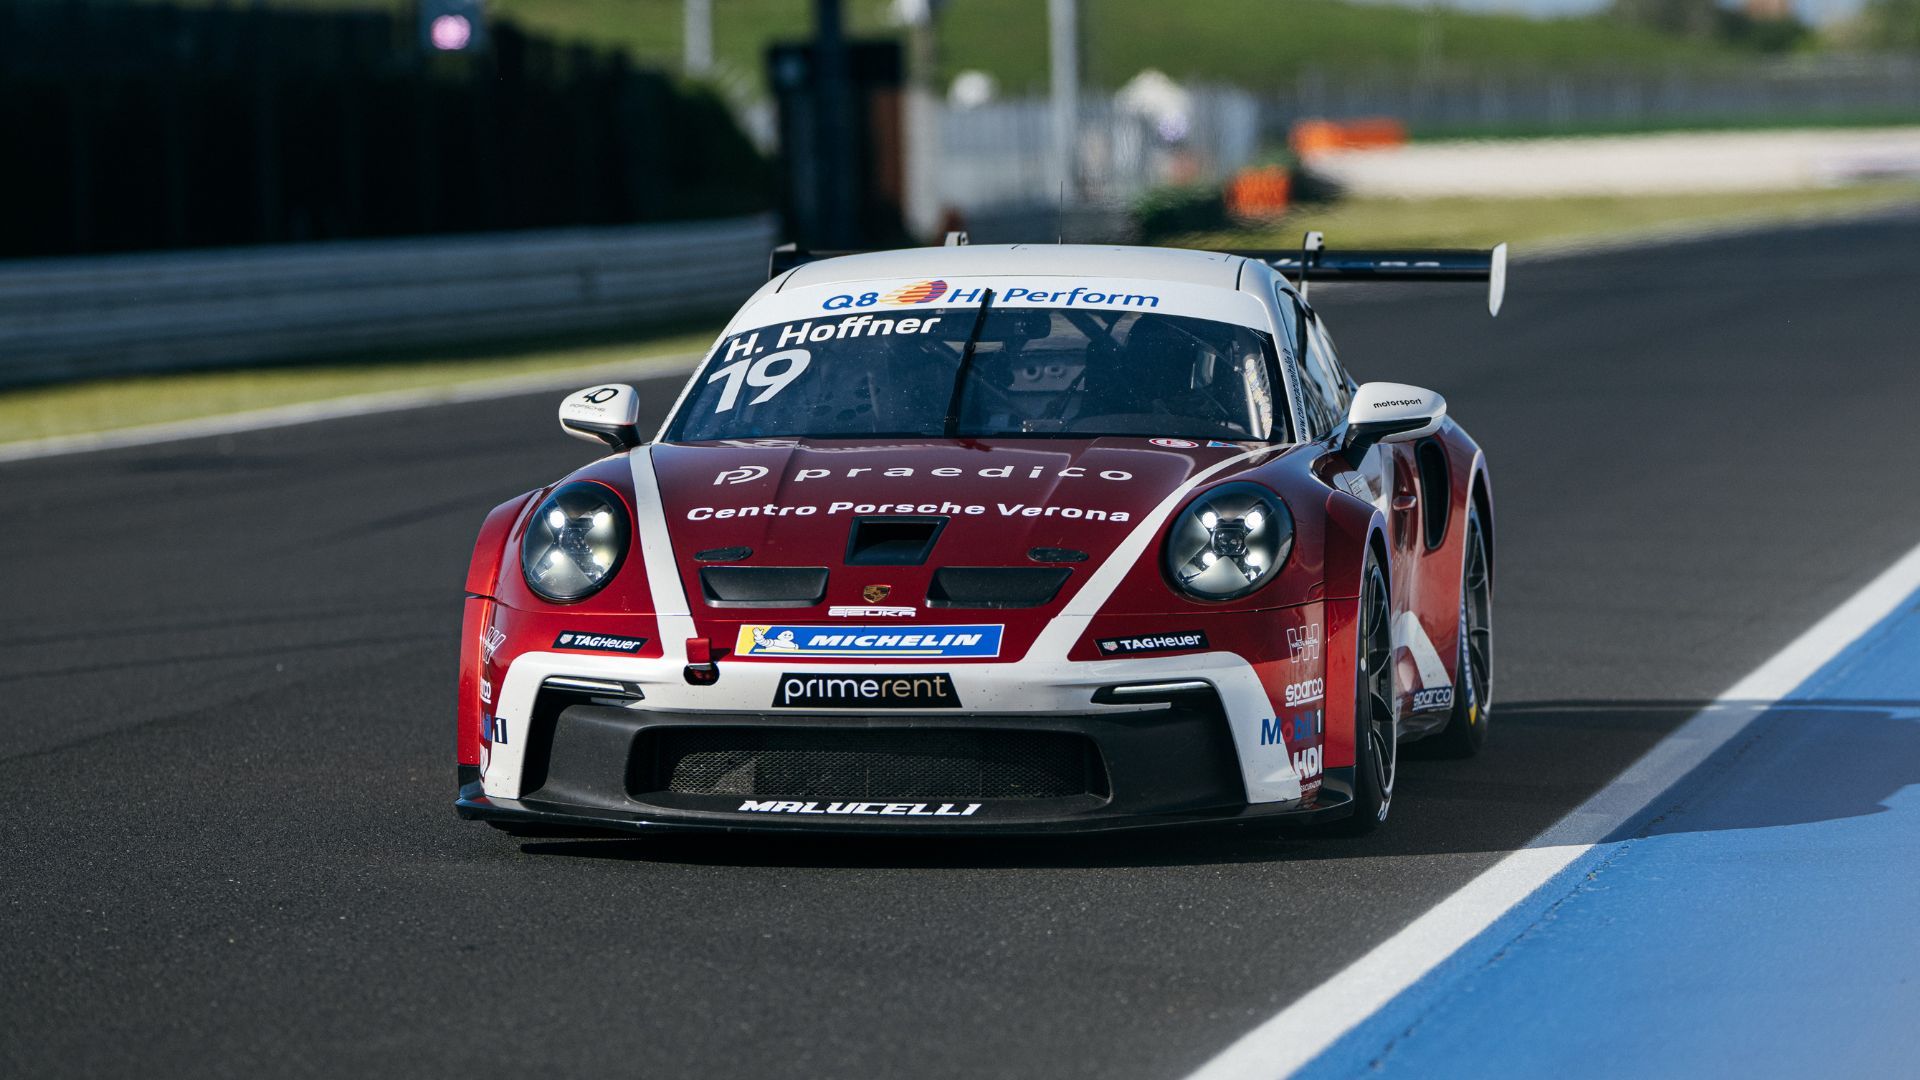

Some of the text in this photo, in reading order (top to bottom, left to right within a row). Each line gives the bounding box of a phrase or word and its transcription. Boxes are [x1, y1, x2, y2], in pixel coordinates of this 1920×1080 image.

[822, 292, 879, 310] Q8
[1003, 287, 1160, 308] Perform
[724, 315, 941, 363] H. Hoffner
[707, 349, 811, 414] 19
[1373, 398, 1422, 409] motorsport
[793, 465, 1133, 483] praedico
[687, 501, 1131, 523] Centro Porsche Verona
[807, 633, 982, 648] MICHELIN
[785, 675, 947, 705] primerent
[1285, 677, 1323, 707] sparco
[1413, 688, 1451, 708] sparco
[1261, 709, 1322, 746] Mobil 1
[1293, 744, 1323, 780] HDI
[738, 800, 982, 816] MALUCELLI
